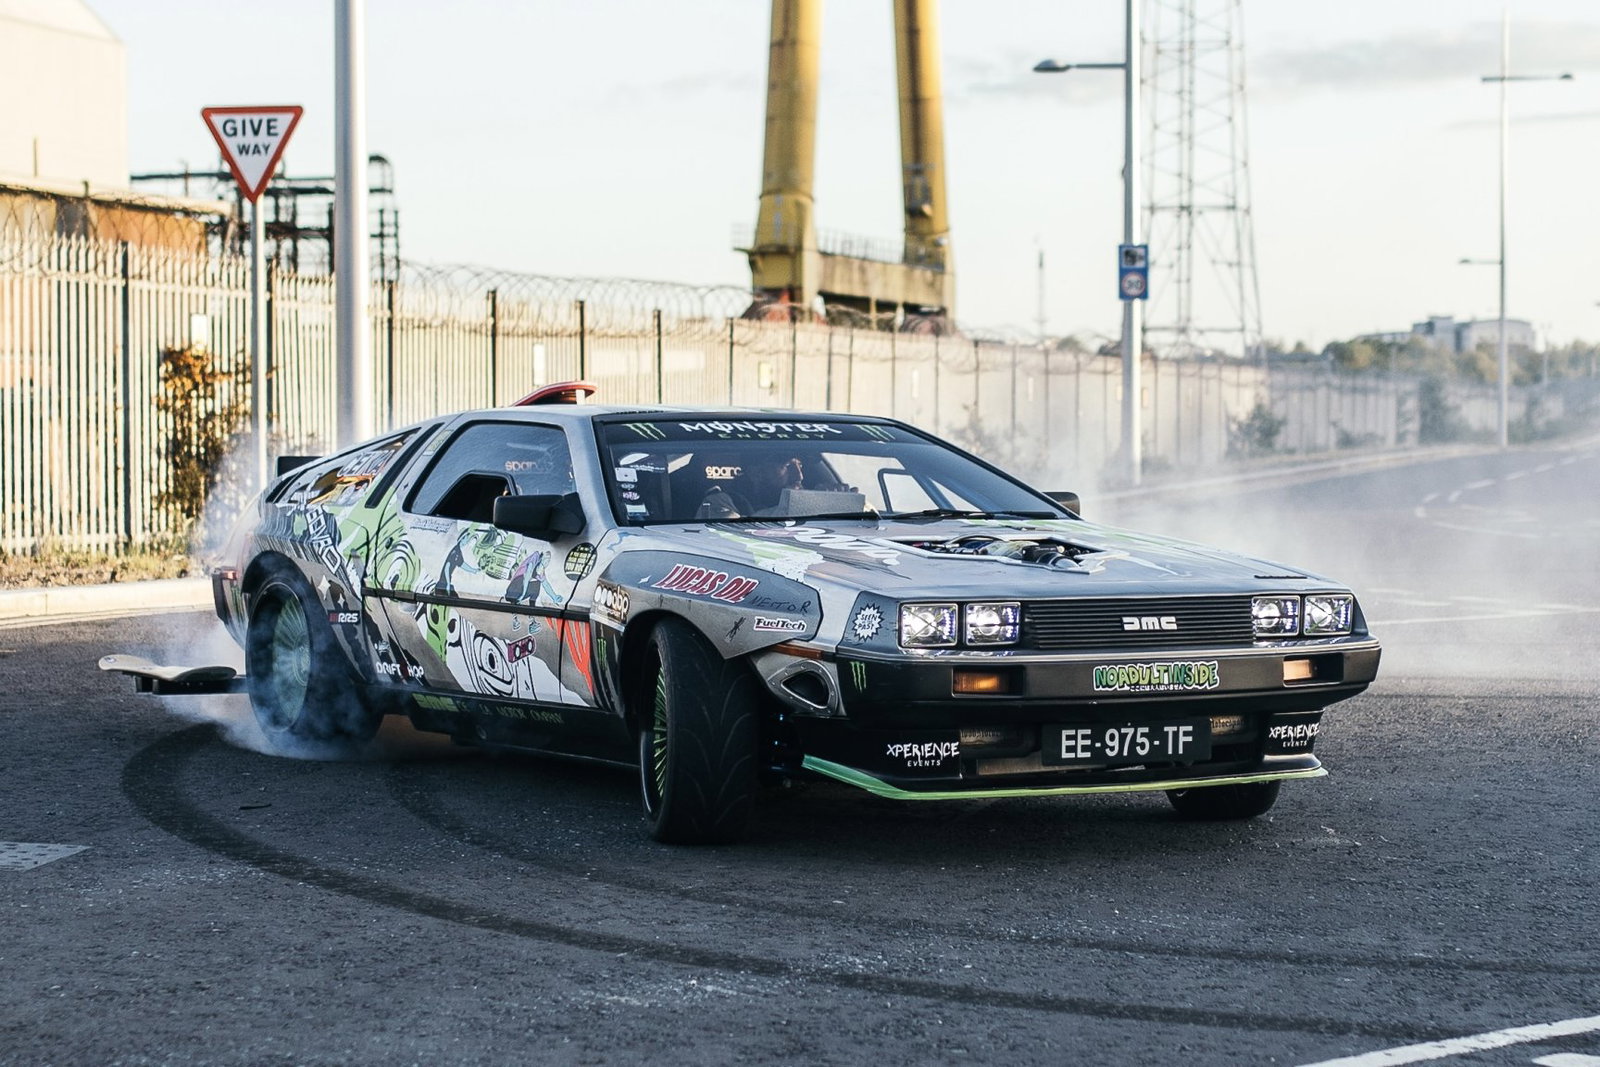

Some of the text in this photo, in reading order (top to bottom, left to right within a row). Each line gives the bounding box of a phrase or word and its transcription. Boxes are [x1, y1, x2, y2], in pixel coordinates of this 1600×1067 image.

[222, 118, 279, 137] GIVE
[237, 144, 271, 155] WAY
[655, 565, 758, 602] LUCAS OIL
[338, 613, 359, 623] RRS
[756, 618, 806, 630] FuelTech
[376, 662, 402, 676] DRIFT
[1268, 722, 1320, 740] XPERIENCE
[886, 741, 960, 761] XPERIENCE
[1283, 740, 1307, 748] EVENTS
